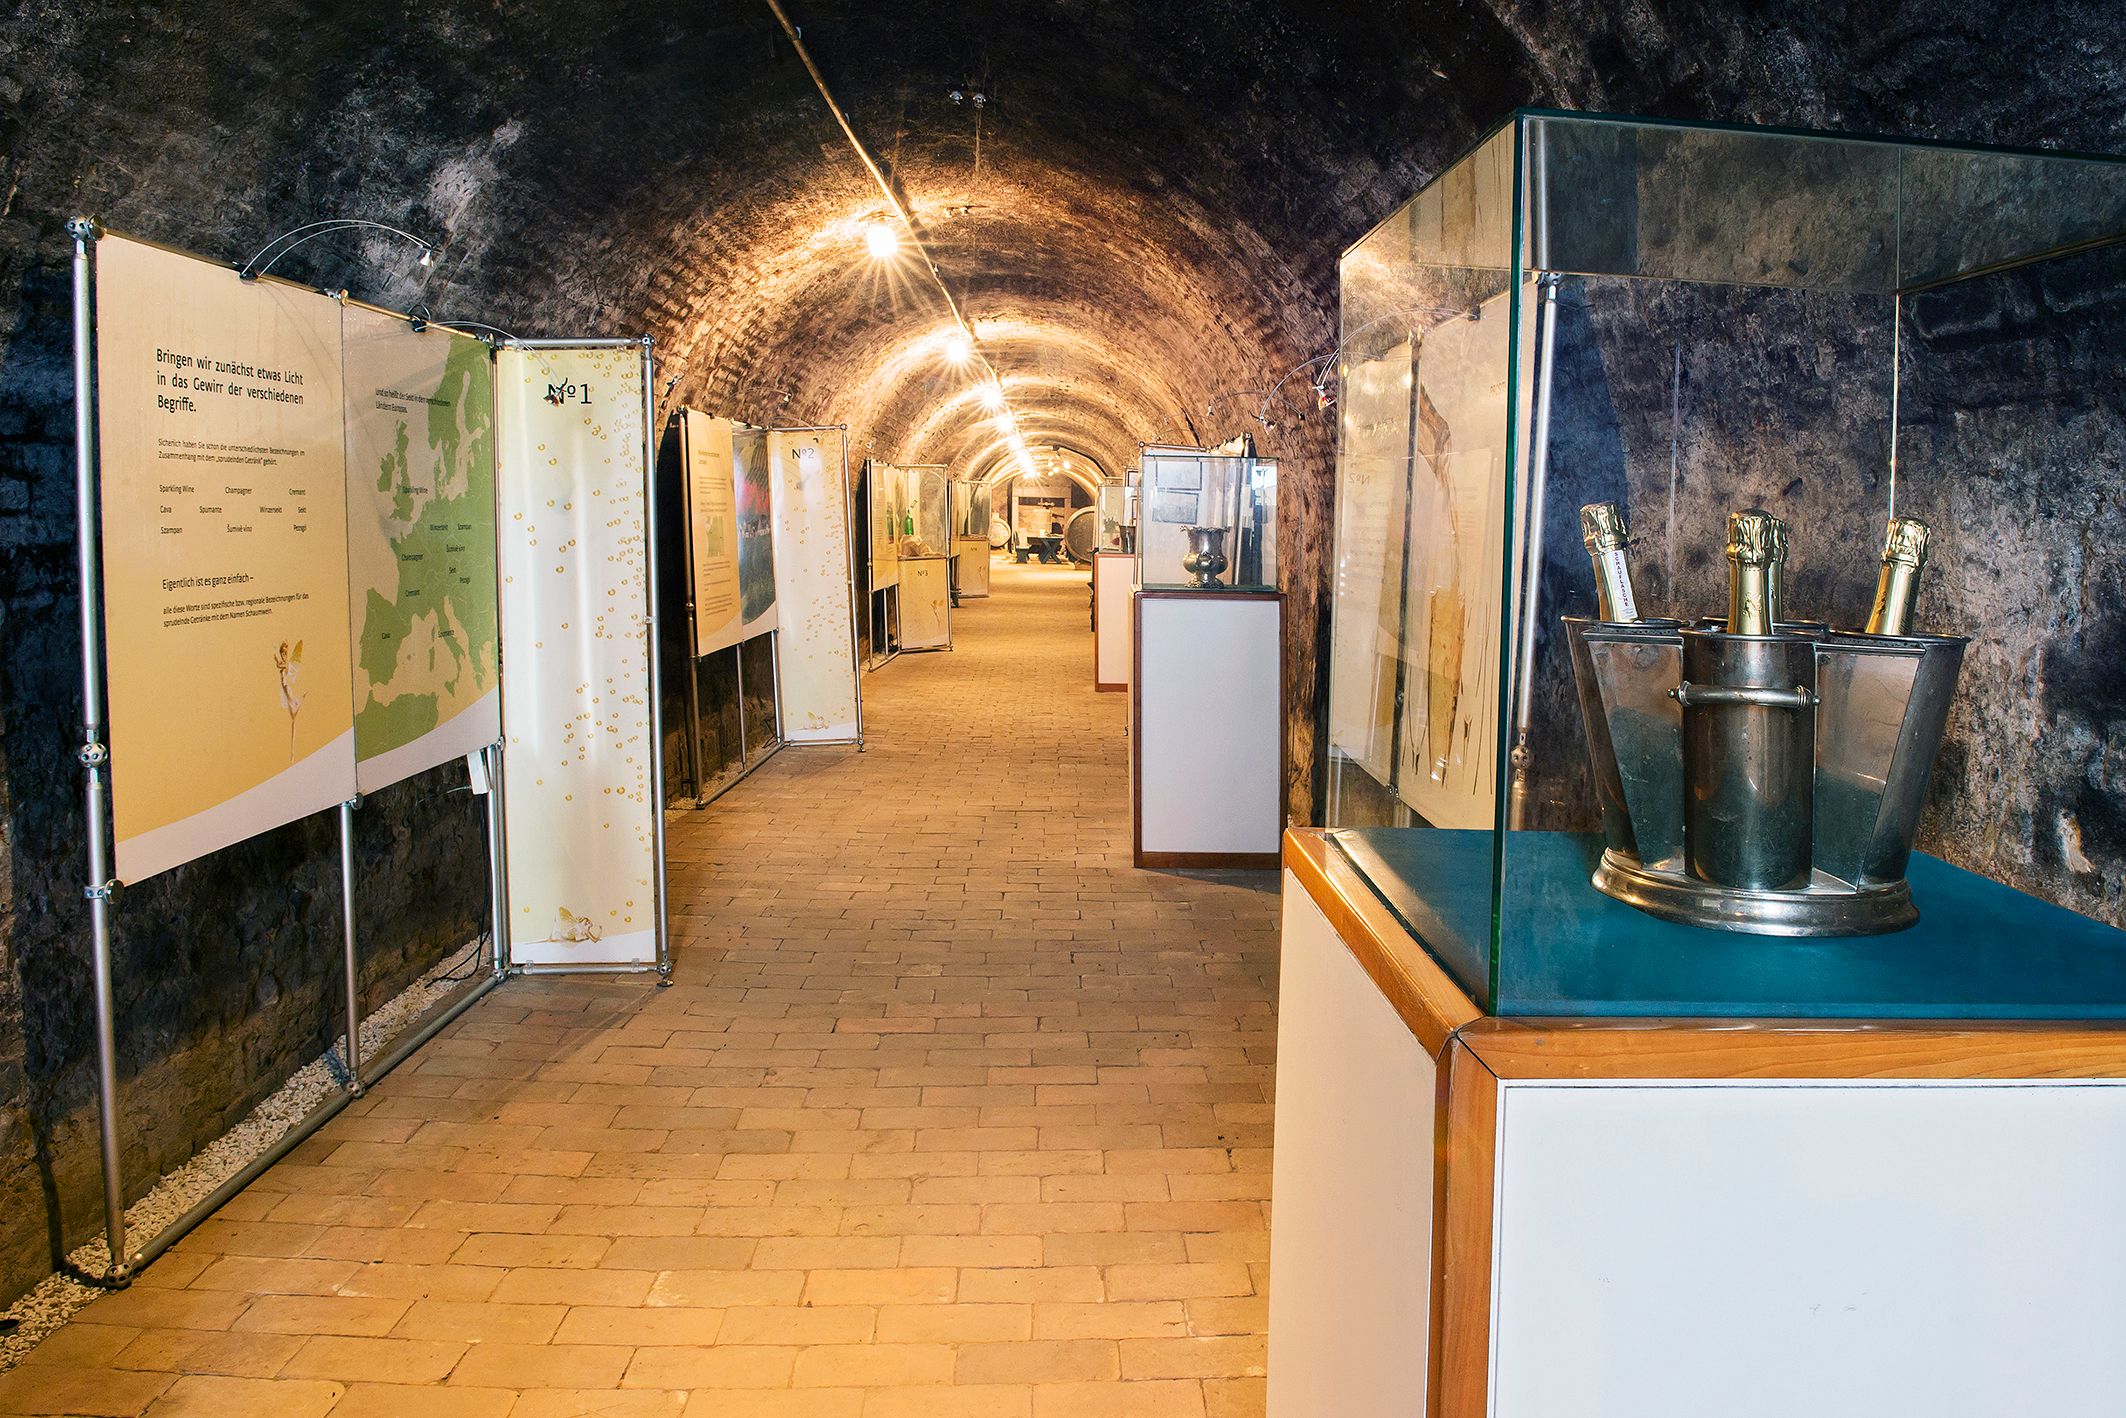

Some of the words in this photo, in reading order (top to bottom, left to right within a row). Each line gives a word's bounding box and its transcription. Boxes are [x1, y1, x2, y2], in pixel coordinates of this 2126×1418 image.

[157, 348, 193, 369] Bringen
[197, 356, 212, 371] wir
[215, 361, 254, 378] zunächst
[257, 367, 281, 382] etwas
[284, 370, 304, 386] Licht
[157, 370, 166, 386] in
[172, 373, 188, 389] das
[193, 376, 224, 394] Gewirr
[228, 382, 243, 397] der
[246, 386, 304, 405] verschiedenen
[157, 394, 197, 413] Begriffe.
[160, 505, 172, 513] Cava
[162, 577, 195, 592] Eigentlich
[196, 576, 204, 587] ist
[204, 578, 211, 586] es
[211, 576, 227, 588] ganz
[227, 573, 250, 584] einfach
